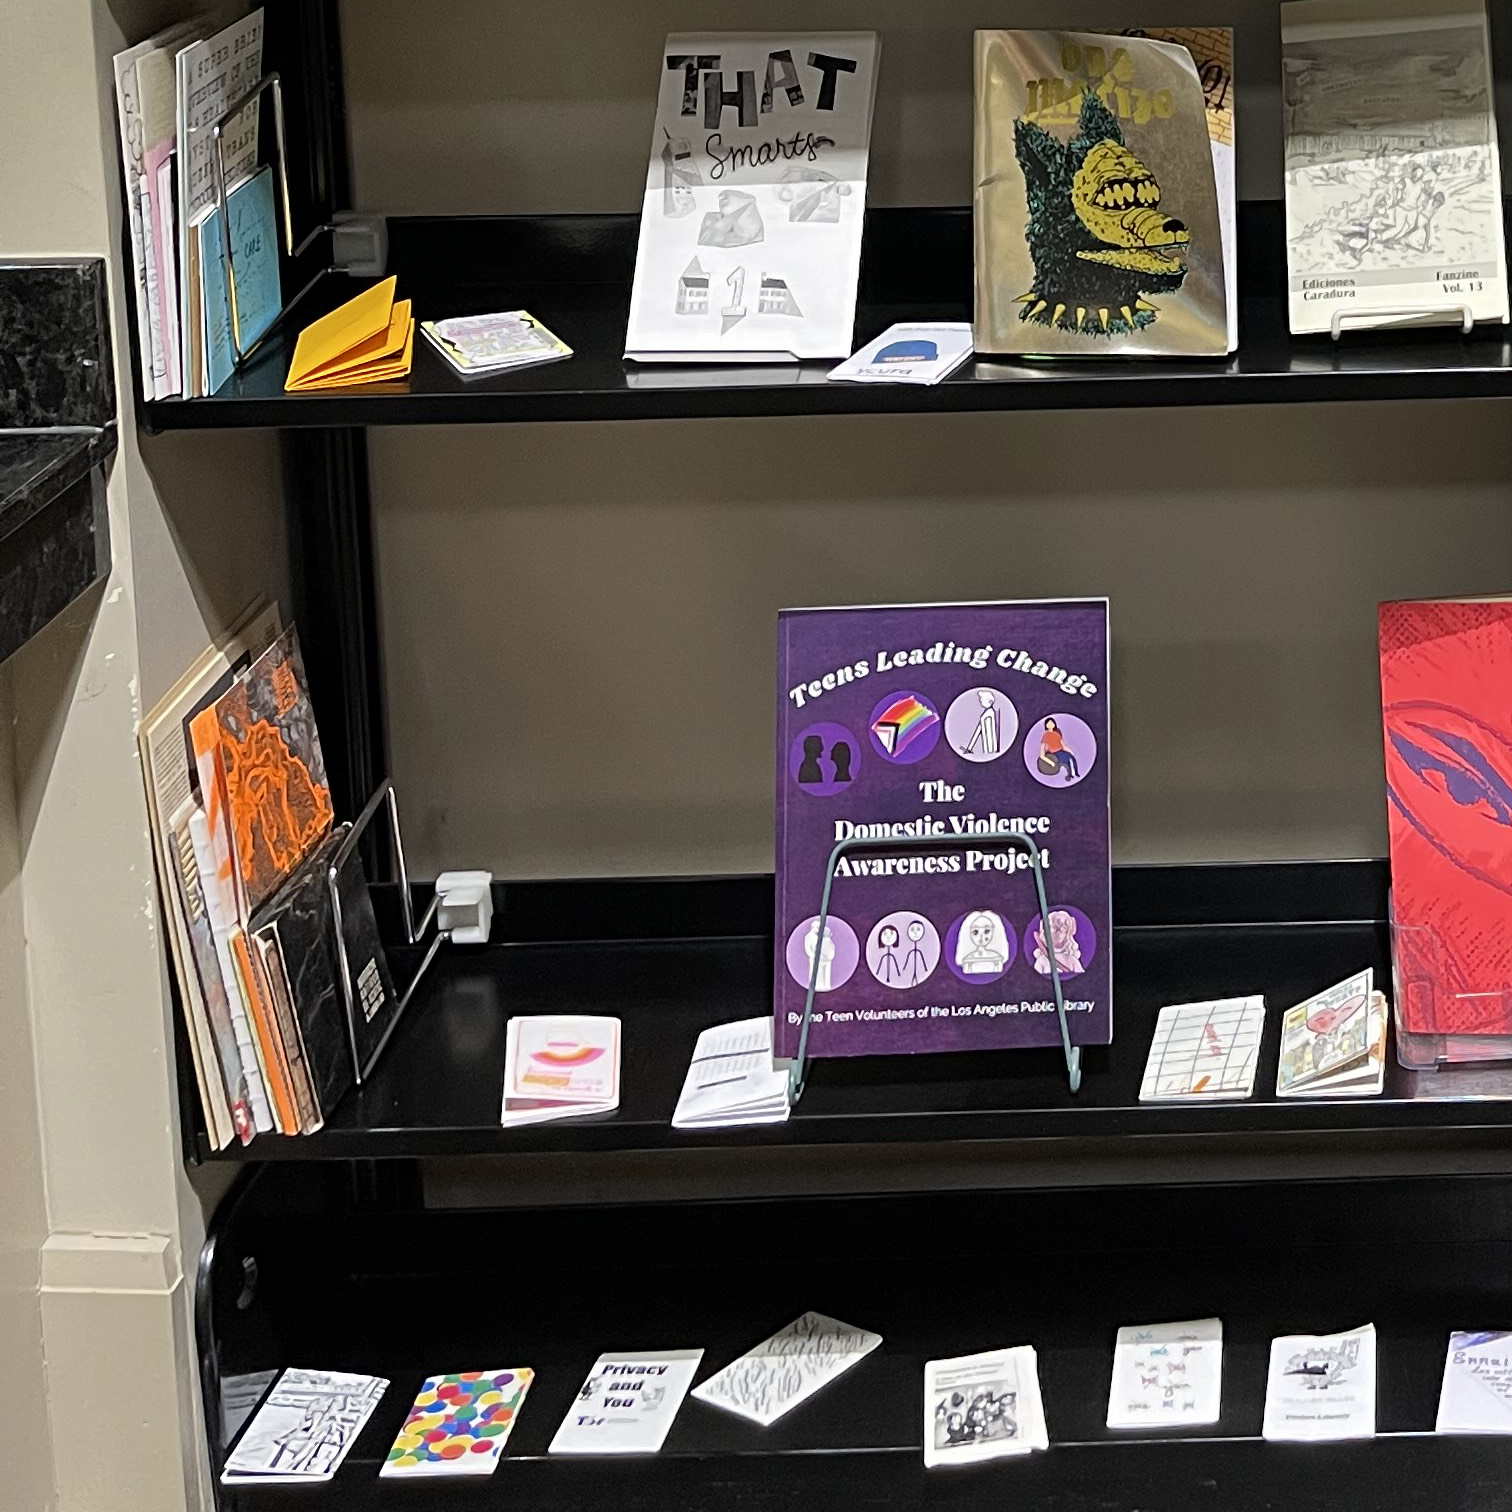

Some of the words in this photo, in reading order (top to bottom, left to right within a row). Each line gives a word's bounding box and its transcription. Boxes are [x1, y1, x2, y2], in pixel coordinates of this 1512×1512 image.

[666, 49, 858, 130] THAT
[705, 133, 835, 179] Smarts
[1303, 278, 1355, 289] Ediciones
[1436, 269, 1479, 281] Fanzine
[1303, 288, 1355, 301] Caradura
[1469, 282, 1483, 292] 13
[789, 659, 870, 708] Teens
[876, 641, 994, 673] Leading
[996, 648, 1098, 699] Change
[919, 779, 966, 803] The
[834, 815, 945, 841] Domestic
[949, 813, 1050, 836] Violence
[833, 853, 961, 877] Awareness
[788, 1012, 803, 1025] By
[826, 1010, 853, 1022] Teen
[855, 1007, 915, 1021] Volunteers
[917, 1006, 929, 1018] of
[931, 1005, 949, 1017] the
[951, 1004, 972, 1017] Los
[974, 1002, 1018, 1016] Angeles
[1021, 1001, 1055, 1013] Public
[602, 1363, 669, 1378] Privacy
[608, 1379, 643, 1392] and
[602, 1395, 634, 1409] You
